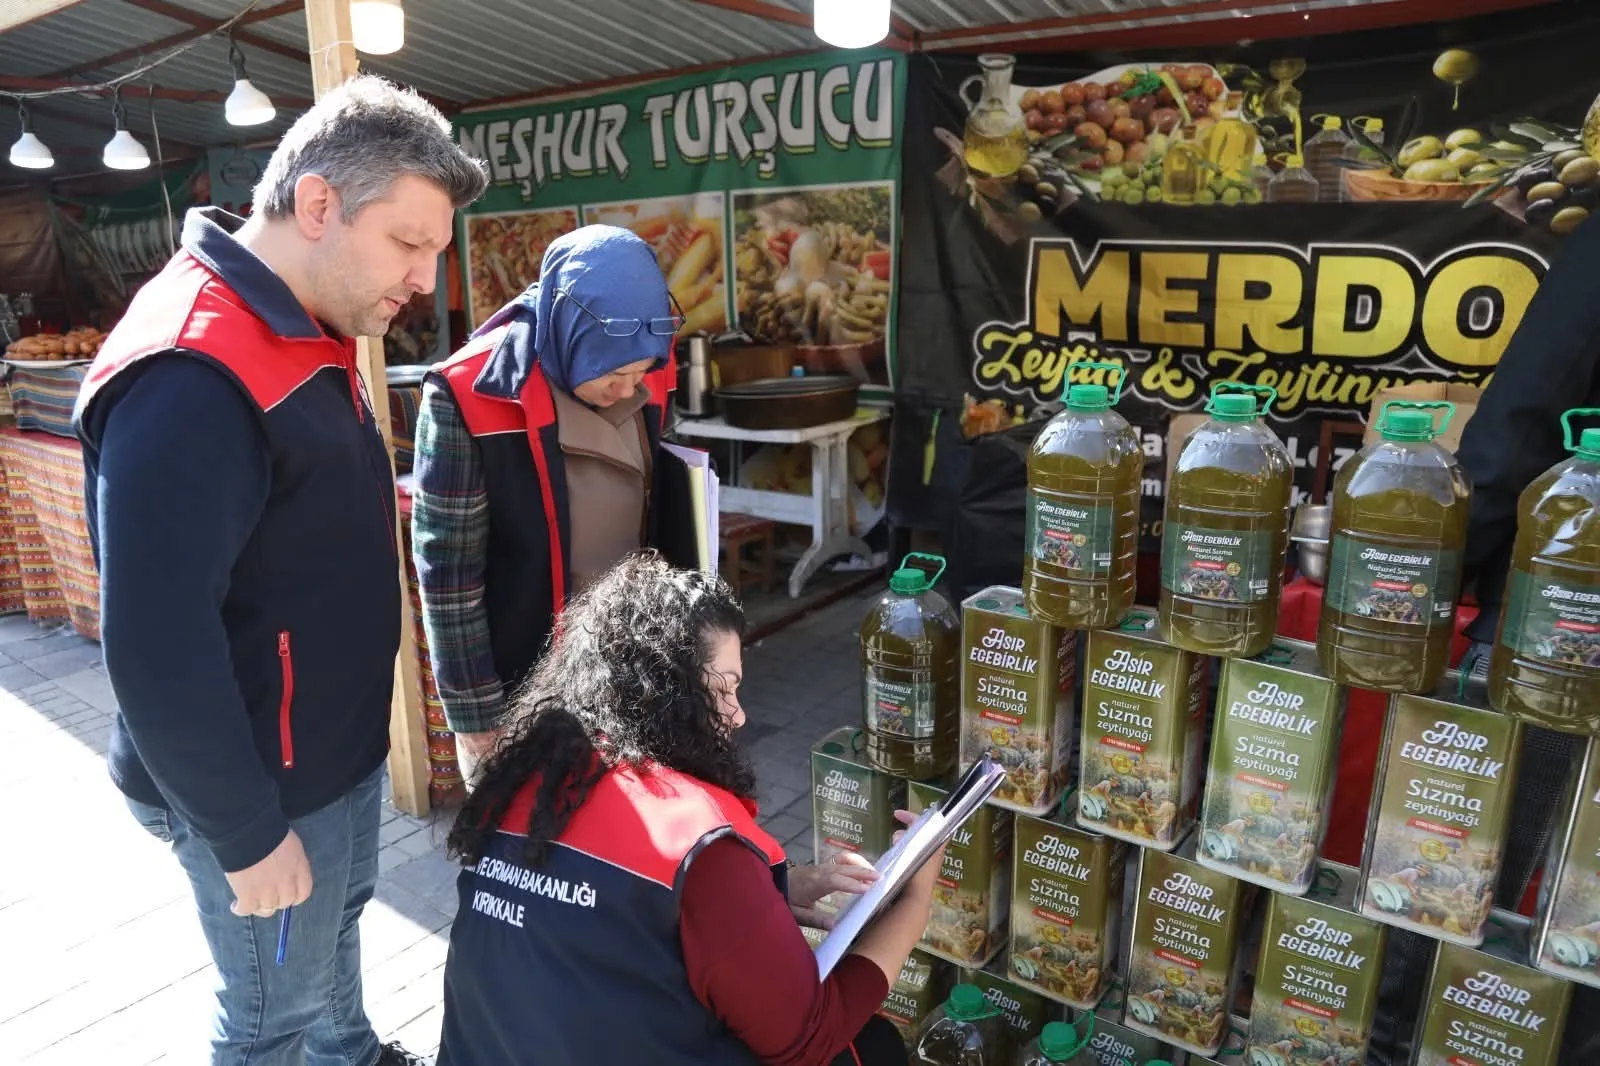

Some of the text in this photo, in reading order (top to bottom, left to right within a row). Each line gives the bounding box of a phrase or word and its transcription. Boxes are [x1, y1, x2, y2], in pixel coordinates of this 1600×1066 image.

[458, 59, 894, 202] MEŞHUR TURŞUCU
[1034, 248, 1540, 366] MERDO
[982, 331, 1127, 395] Zeytin
[1140, 347, 1195, 398] &
[981, 628, 1025, 653] ASIR
[969, 647, 1038, 674] EGEBİRLİK
[1104, 650, 1153, 676] ASIR
[976, 677, 1027, 702] Sızma
[1090, 668, 1166, 698] EGEBİRLİK
[1247, 681, 1304, 711] ASIR
[976, 695, 1027, 715] zeytinyağı
[1097, 701, 1153, 729] Sızma
[1111, 699, 1140, 711] naturel
[1229, 701, 1318, 735] EGEBİRLİK
[1097, 720, 1152, 743] zeytinyağı
[1422, 721, 1488, 753] ASIR
[1235, 736, 1300, 766] Sızma
[1400, 741, 1504, 778] EGEBİRLİK
[824, 769, 859, 793] ASIR
[1233, 755, 1297, 780] zeytinyağı
[816, 784, 870, 810] EGEBİRLİK
[1406, 779, 1483, 812] Sızma
[1426, 777, 1465, 792] naturel
[822, 810, 863, 833] Sızma
[1404, 800, 1480, 827] zeytinyağı
[822, 824, 863, 844] zeytinyağı
[1035, 835, 1080, 861] ASIR
[1023, 849, 1091, 881] EGEBİRLİK
[486, 858, 521, 889] ORMAN
[518, 868, 597, 908] BAKANLIĞI
[1030, 878, 1080, 906] Sızma
[1163, 872, 1214, 901] ASIR
[472, 890, 525, 928] KIRIKKALE
[1029, 894, 1080, 917] zeytinyağı
[1147, 886, 1226, 923] EGEBİRLİK
[1153, 918, 1212, 948] Sızma
[1295, 917, 1353, 947] ASIR
[1152, 934, 1209, 960] zeytinyağı
[1277, 933, 1366, 970] EGEBİRLİK
[1283, 964, 1348, 997] Sızma
[1300, 964, 1334, 979] naturel
[888, 991, 917, 1009] zma
[982, 987, 1021, 1013] ASIR
[1281, 982, 1346, 1009] zeytinyağı
[1463, 971, 1531, 1006] ASIR
[882, 1001, 917, 1018] ytinyağı
[1442, 985, 1547, 1032] EGEBİRLİK
[1447, 1020, 1525, 1060] Sızma
[1468, 1021, 1508, 1039] naturel
[1090, 1032, 1136, 1059] ASIR
[1444, 1038, 1520, 1066] zeytinyağ
